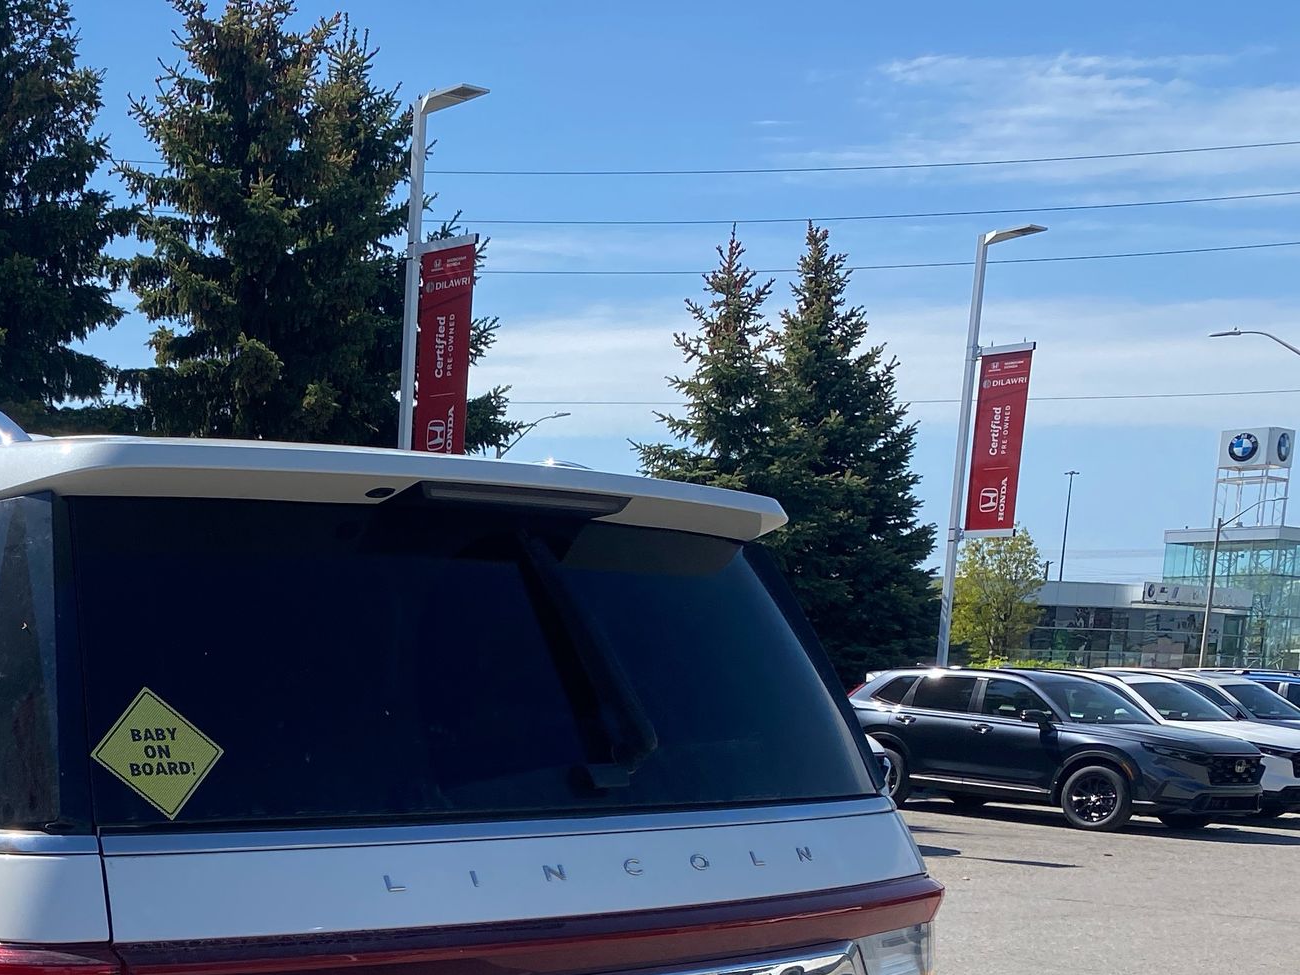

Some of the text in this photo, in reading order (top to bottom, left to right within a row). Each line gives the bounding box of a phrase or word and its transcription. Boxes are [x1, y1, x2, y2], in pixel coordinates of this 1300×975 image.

[435, 276, 471, 291] DILAWRI
[435, 315, 447, 378] Certified
[446, 313, 456, 377] PRE-OWNED
[992, 376, 1028, 387] DILAWRI
[989, 406, 1003, 456] Certified
[997, 476, 1008, 521] HONDA
[129, 727, 178, 742] BABY
[143, 744, 171, 759] ON
[129, 761, 197, 777] BOARD!
[382, 844, 813, 894] LINCOLN
